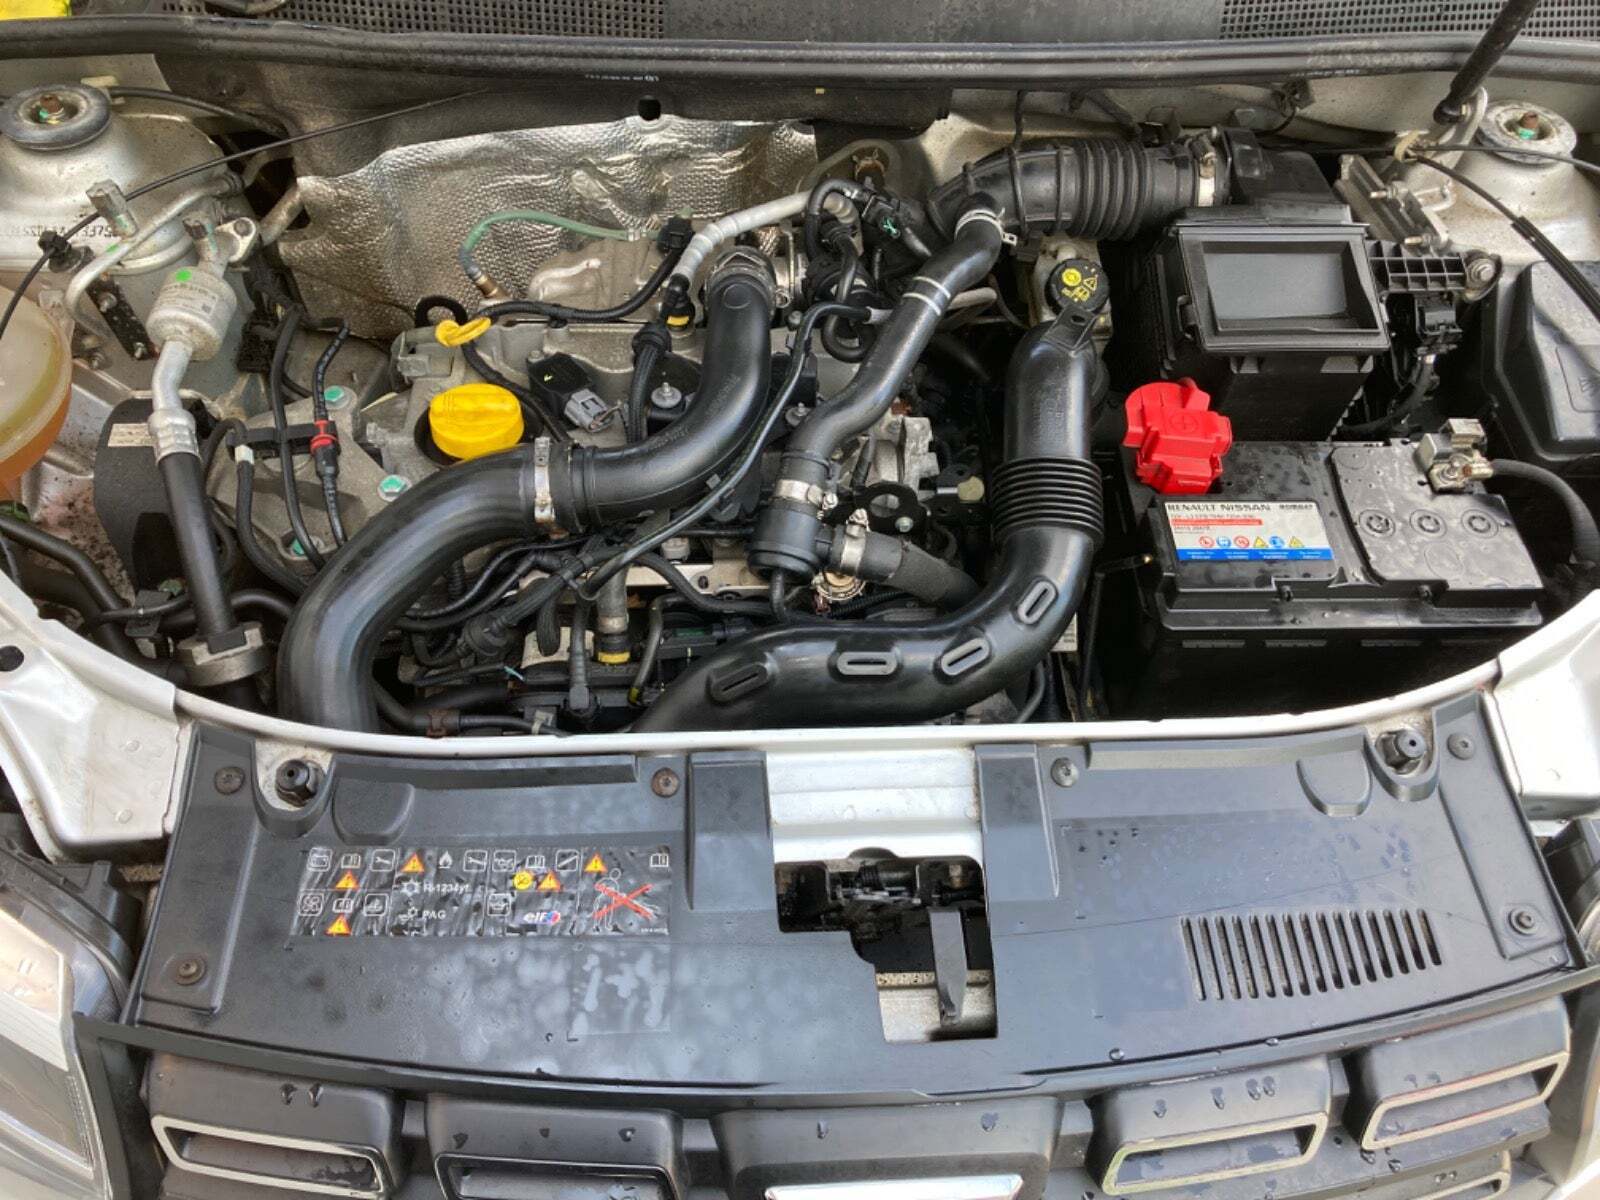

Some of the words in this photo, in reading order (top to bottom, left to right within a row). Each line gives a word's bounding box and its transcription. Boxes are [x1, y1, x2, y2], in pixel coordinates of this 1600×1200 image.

[1167, 503, 1217, 512] RENAULT
[1220, 503, 1272, 511] NISSAN
[421, 909, 447, 921] PAG
